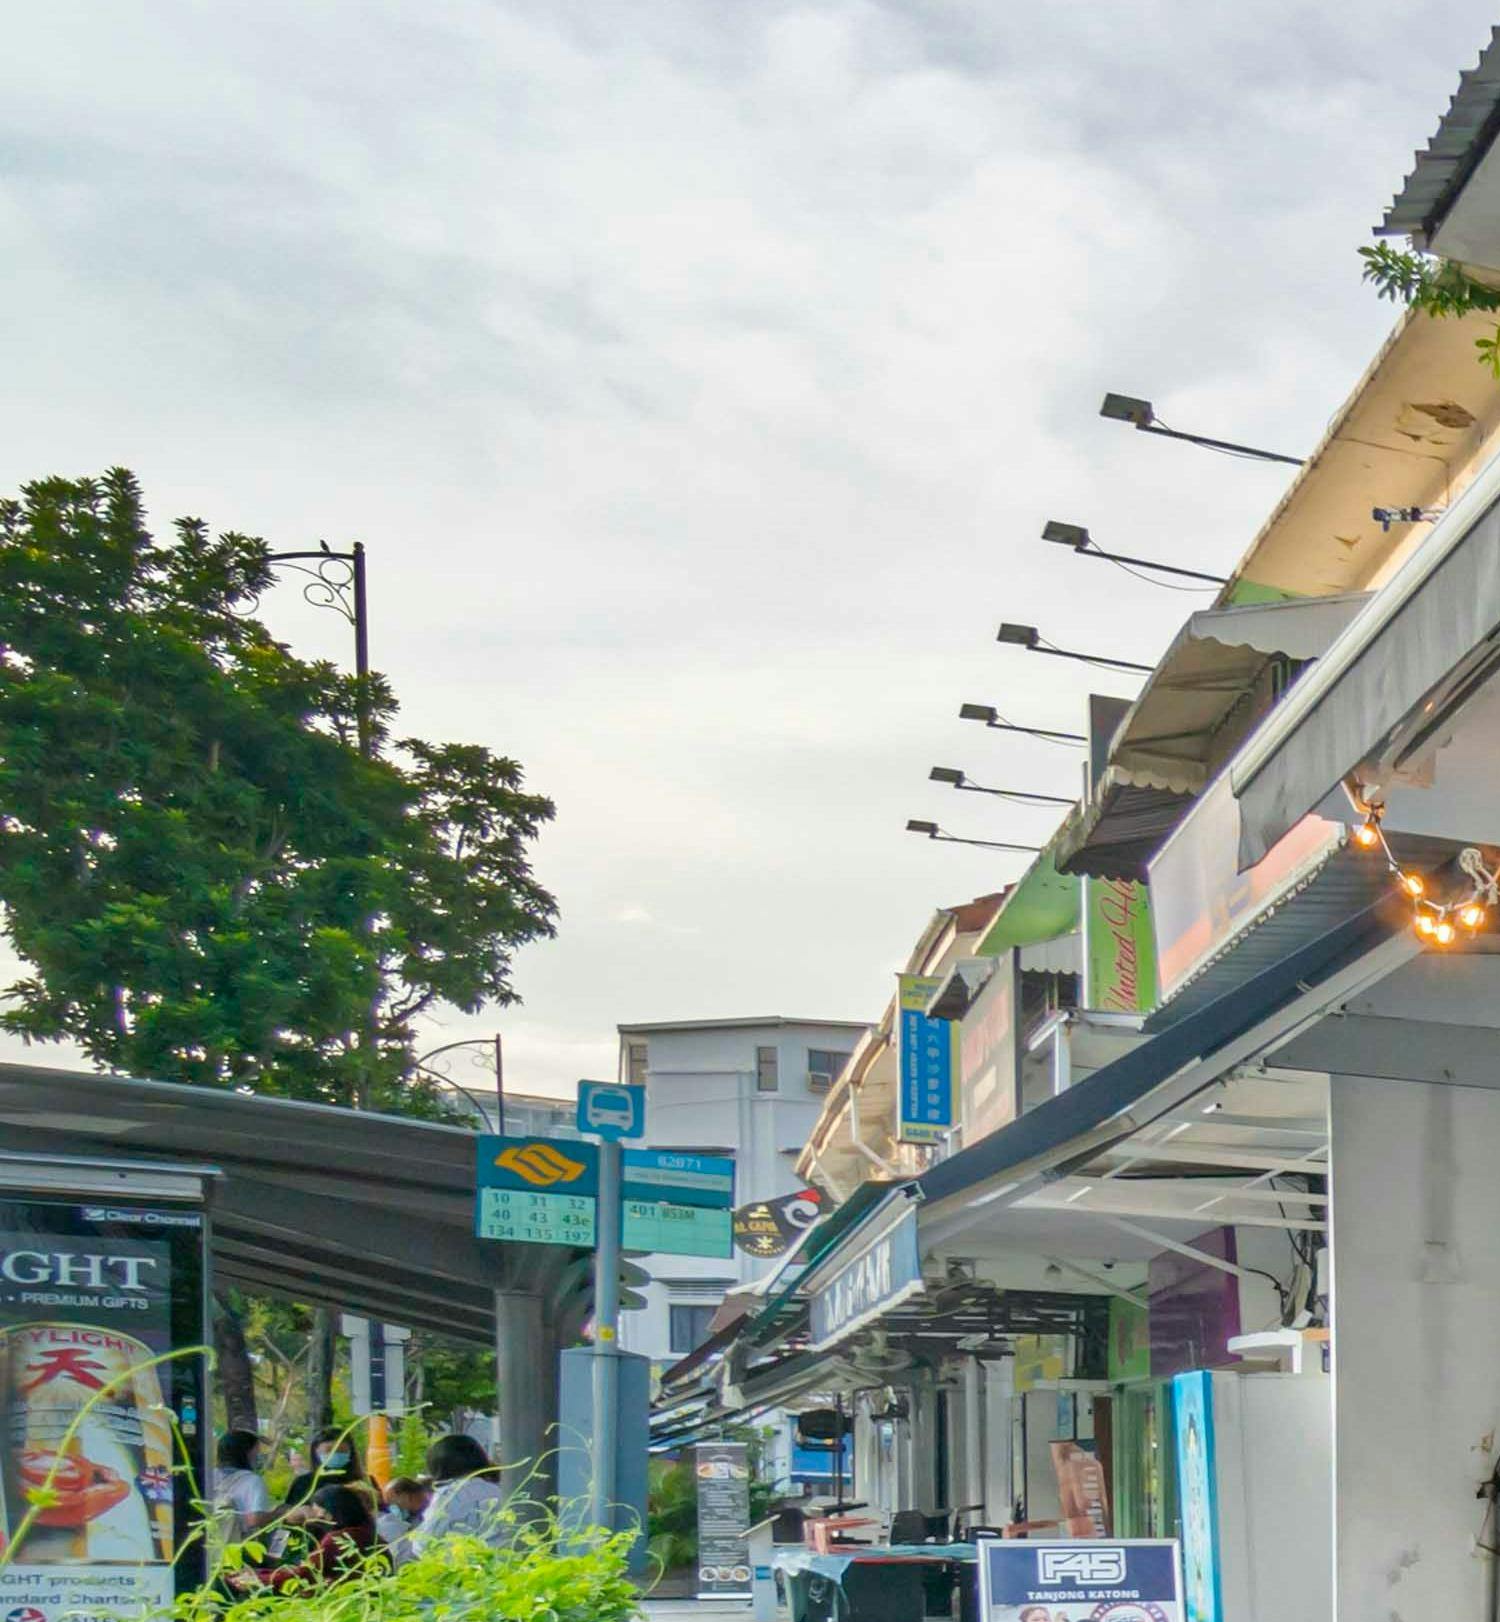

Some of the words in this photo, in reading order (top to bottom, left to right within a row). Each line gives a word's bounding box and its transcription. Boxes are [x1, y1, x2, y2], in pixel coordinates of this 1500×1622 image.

[492, 1209, 510, 1221] 40
[0, 1250, 157, 1290] GHT
[21, 1291, 99, 1307] PREMIUM
[102, 1296, 149, 1310] GIFTS
[28, 1330, 138, 1353] YLIGHT
[1039, 1549, 1125, 1583] F45
[70, 1594, 161, 1605] Charted
[1026, 1590, 1086, 1602] TANJONG
[1087, 1589, 1141, 1600] KATONG
